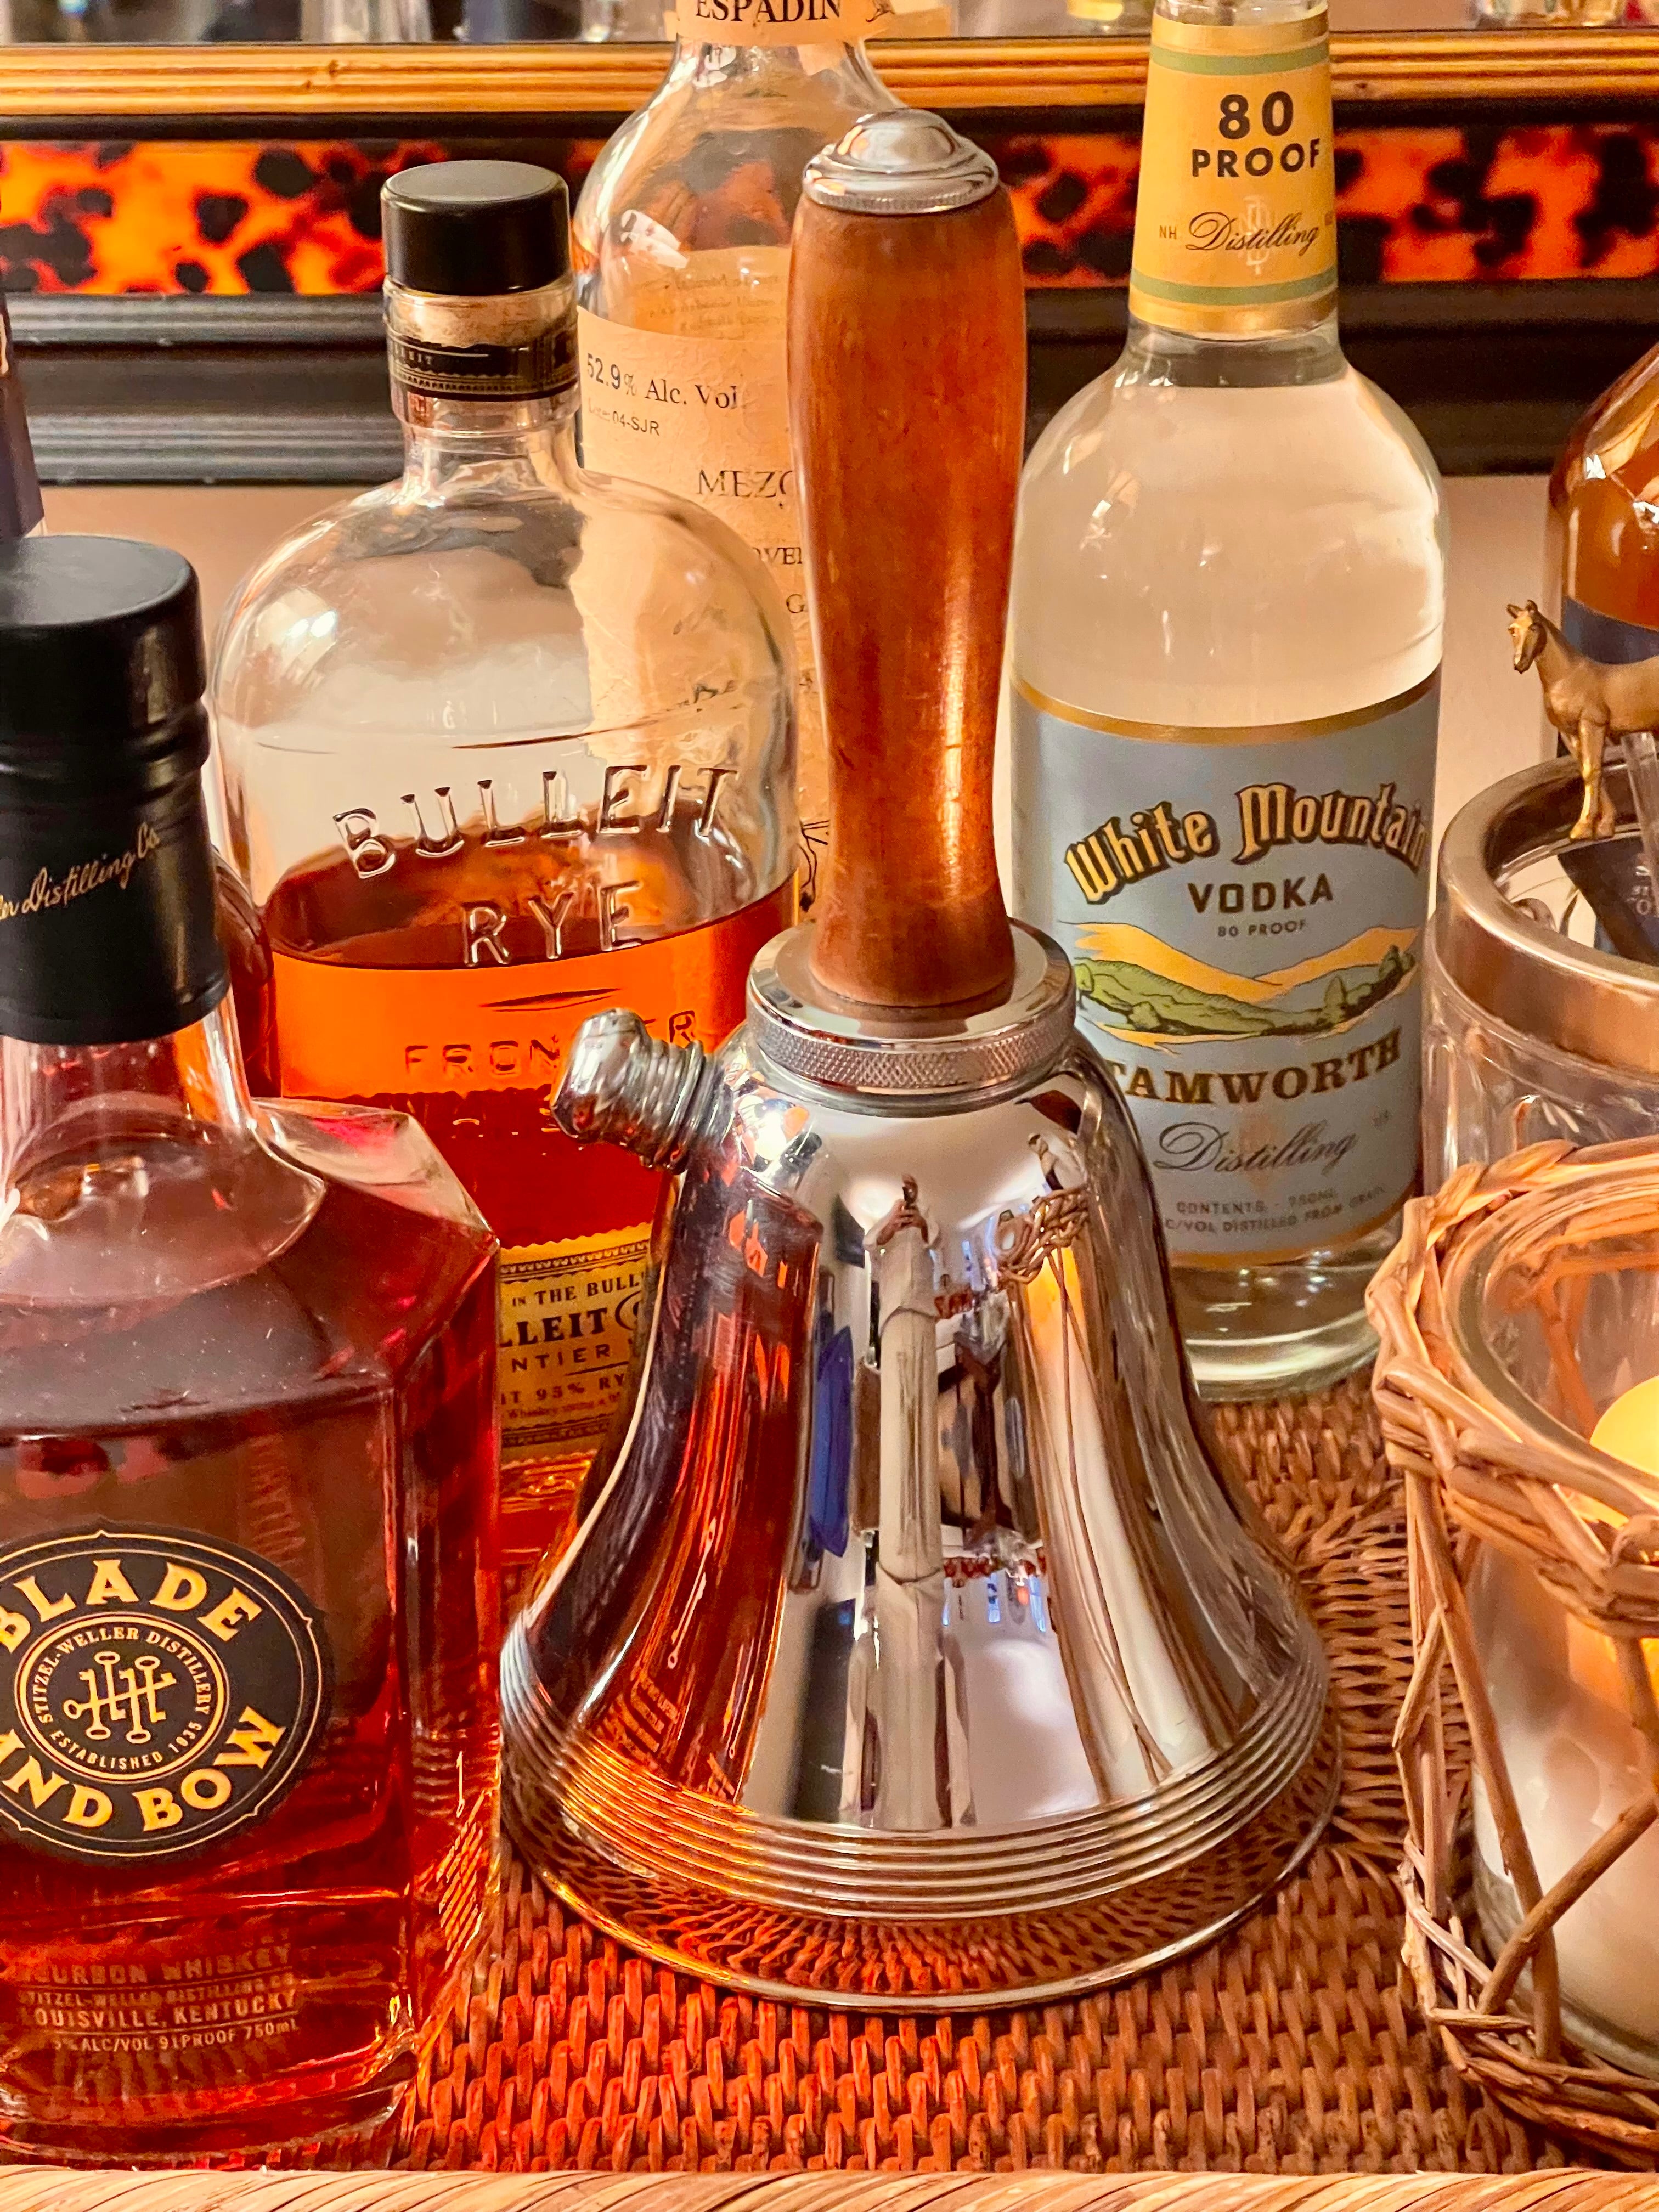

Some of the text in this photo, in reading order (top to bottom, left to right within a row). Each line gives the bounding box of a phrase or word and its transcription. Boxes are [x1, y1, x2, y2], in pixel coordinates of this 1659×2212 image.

[1218, 91, 1294, 140] 80
[1192, 138, 1321, 178] PROOF
[1159, 225, 1177, 240] NH
[1185, 211, 1320, 257] Distilling
[645, 379, 687, 405] Alc.
[332, 765, 738, 879] BULLEIT
[1063, 782, 1426, 905] White Mountain
[21, 851, 136, 914] Distilling
[1187, 873, 1334, 913] VODKA
[462, 881, 644, 967] RYE
[1248, 918, 1307, 936] PROOF
[405, 1009, 697, 1076] FRONR
[1152, 1118, 1357, 1173] Distilling
[535, 1286, 577, 1305] THE
[0, 1559, 263, 1653] BLADE
[145, 1631, 212, 1716] DISTILLERY
[50, 1730, 163, 1770] ESTABLISHED
[132, 1706, 286, 1832] BOW
[173, 1989, 296, 2025] KENTUCKY
